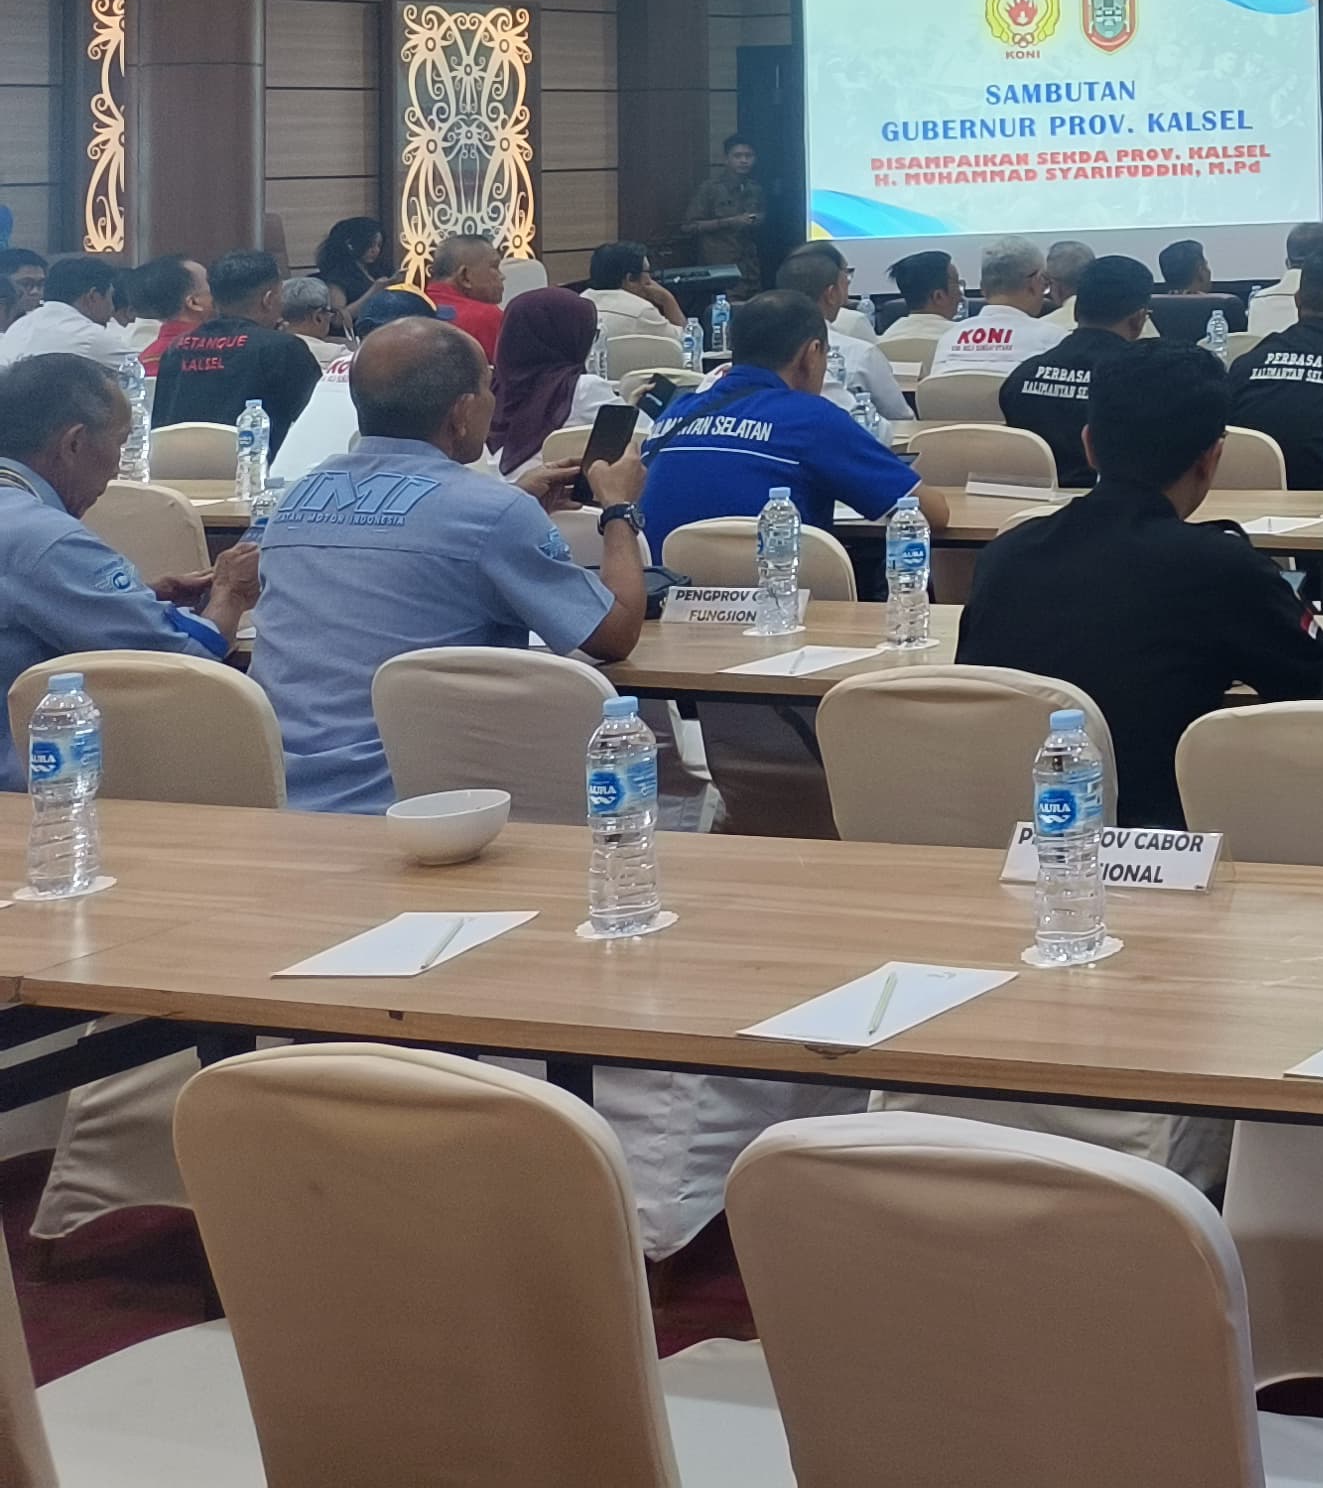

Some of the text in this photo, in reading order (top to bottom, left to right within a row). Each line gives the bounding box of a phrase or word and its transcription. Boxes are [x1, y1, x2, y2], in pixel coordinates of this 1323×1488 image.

[1005, 50, 1041, 59] KONI
[985, 80, 1135, 105] SAMBUTAN
[881, 109, 1254, 142] GUBERNUR PROV. KALSEL
[870, 144, 1271, 171] DISAMPAIKAN SEKDA PROV. KALSEL
[874, 160, 1261, 187] H. MUHAMMAD SYARIFUDDIN, M.Pd
[957, 327, 1013, 344] KONI
[1035, 366, 1091, 383] PERBASA
[711, 415, 773, 442] SELATAN
[675, 590, 750, 602] PENGPROV
[689, 610, 758, 622] FUNGSION
[1135, 831, 1205, 852] CABOR
[1100, 862, 1164, 884] IONAL
